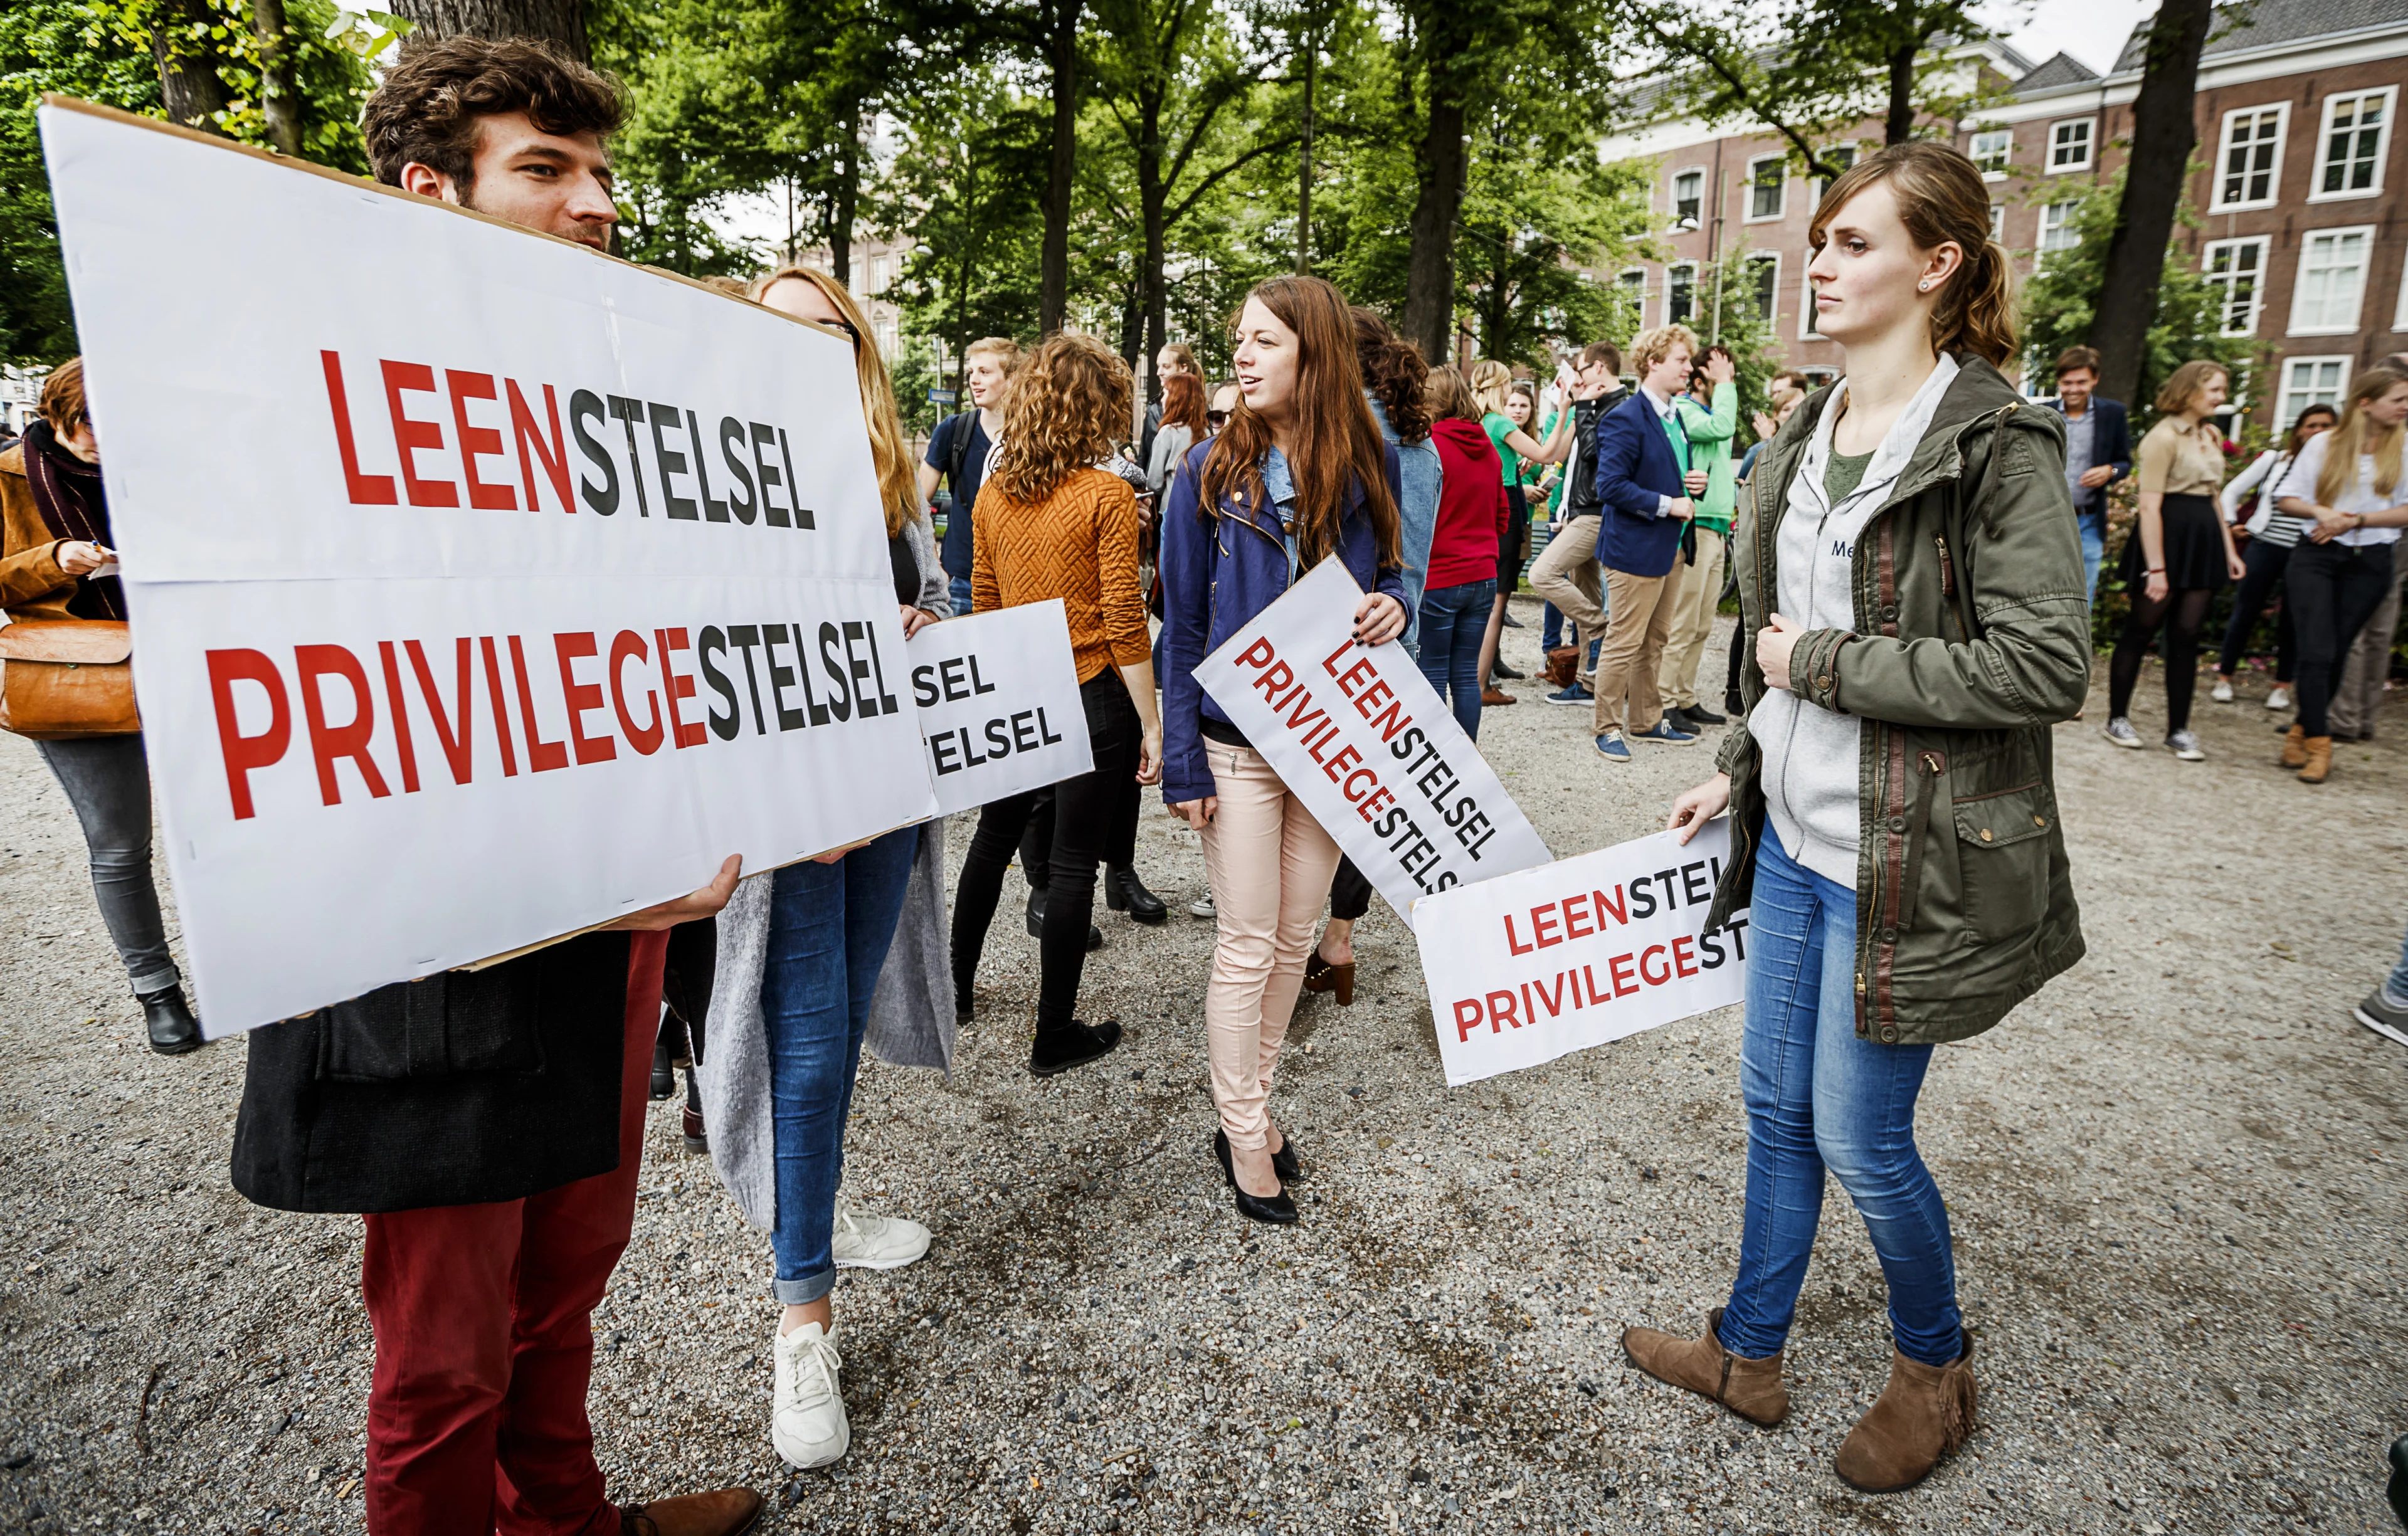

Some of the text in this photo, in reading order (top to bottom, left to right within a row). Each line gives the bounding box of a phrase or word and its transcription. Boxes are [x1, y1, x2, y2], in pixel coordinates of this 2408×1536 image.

[321, 350, 815, 530] LEENSTELSEL
[206, 621, 898, 820] PRIVILEGESTELSEL
[911, 655, 995, 708] SEL
[923, 707, 1062, 776] ELSEL
[1233, 636, 1464, 895] PRIVILEGESTELS
[1322, 638, 1496, 862] LEENSTELSEL
[1453, 917, 1750, 1043] PRIVILEGEST
